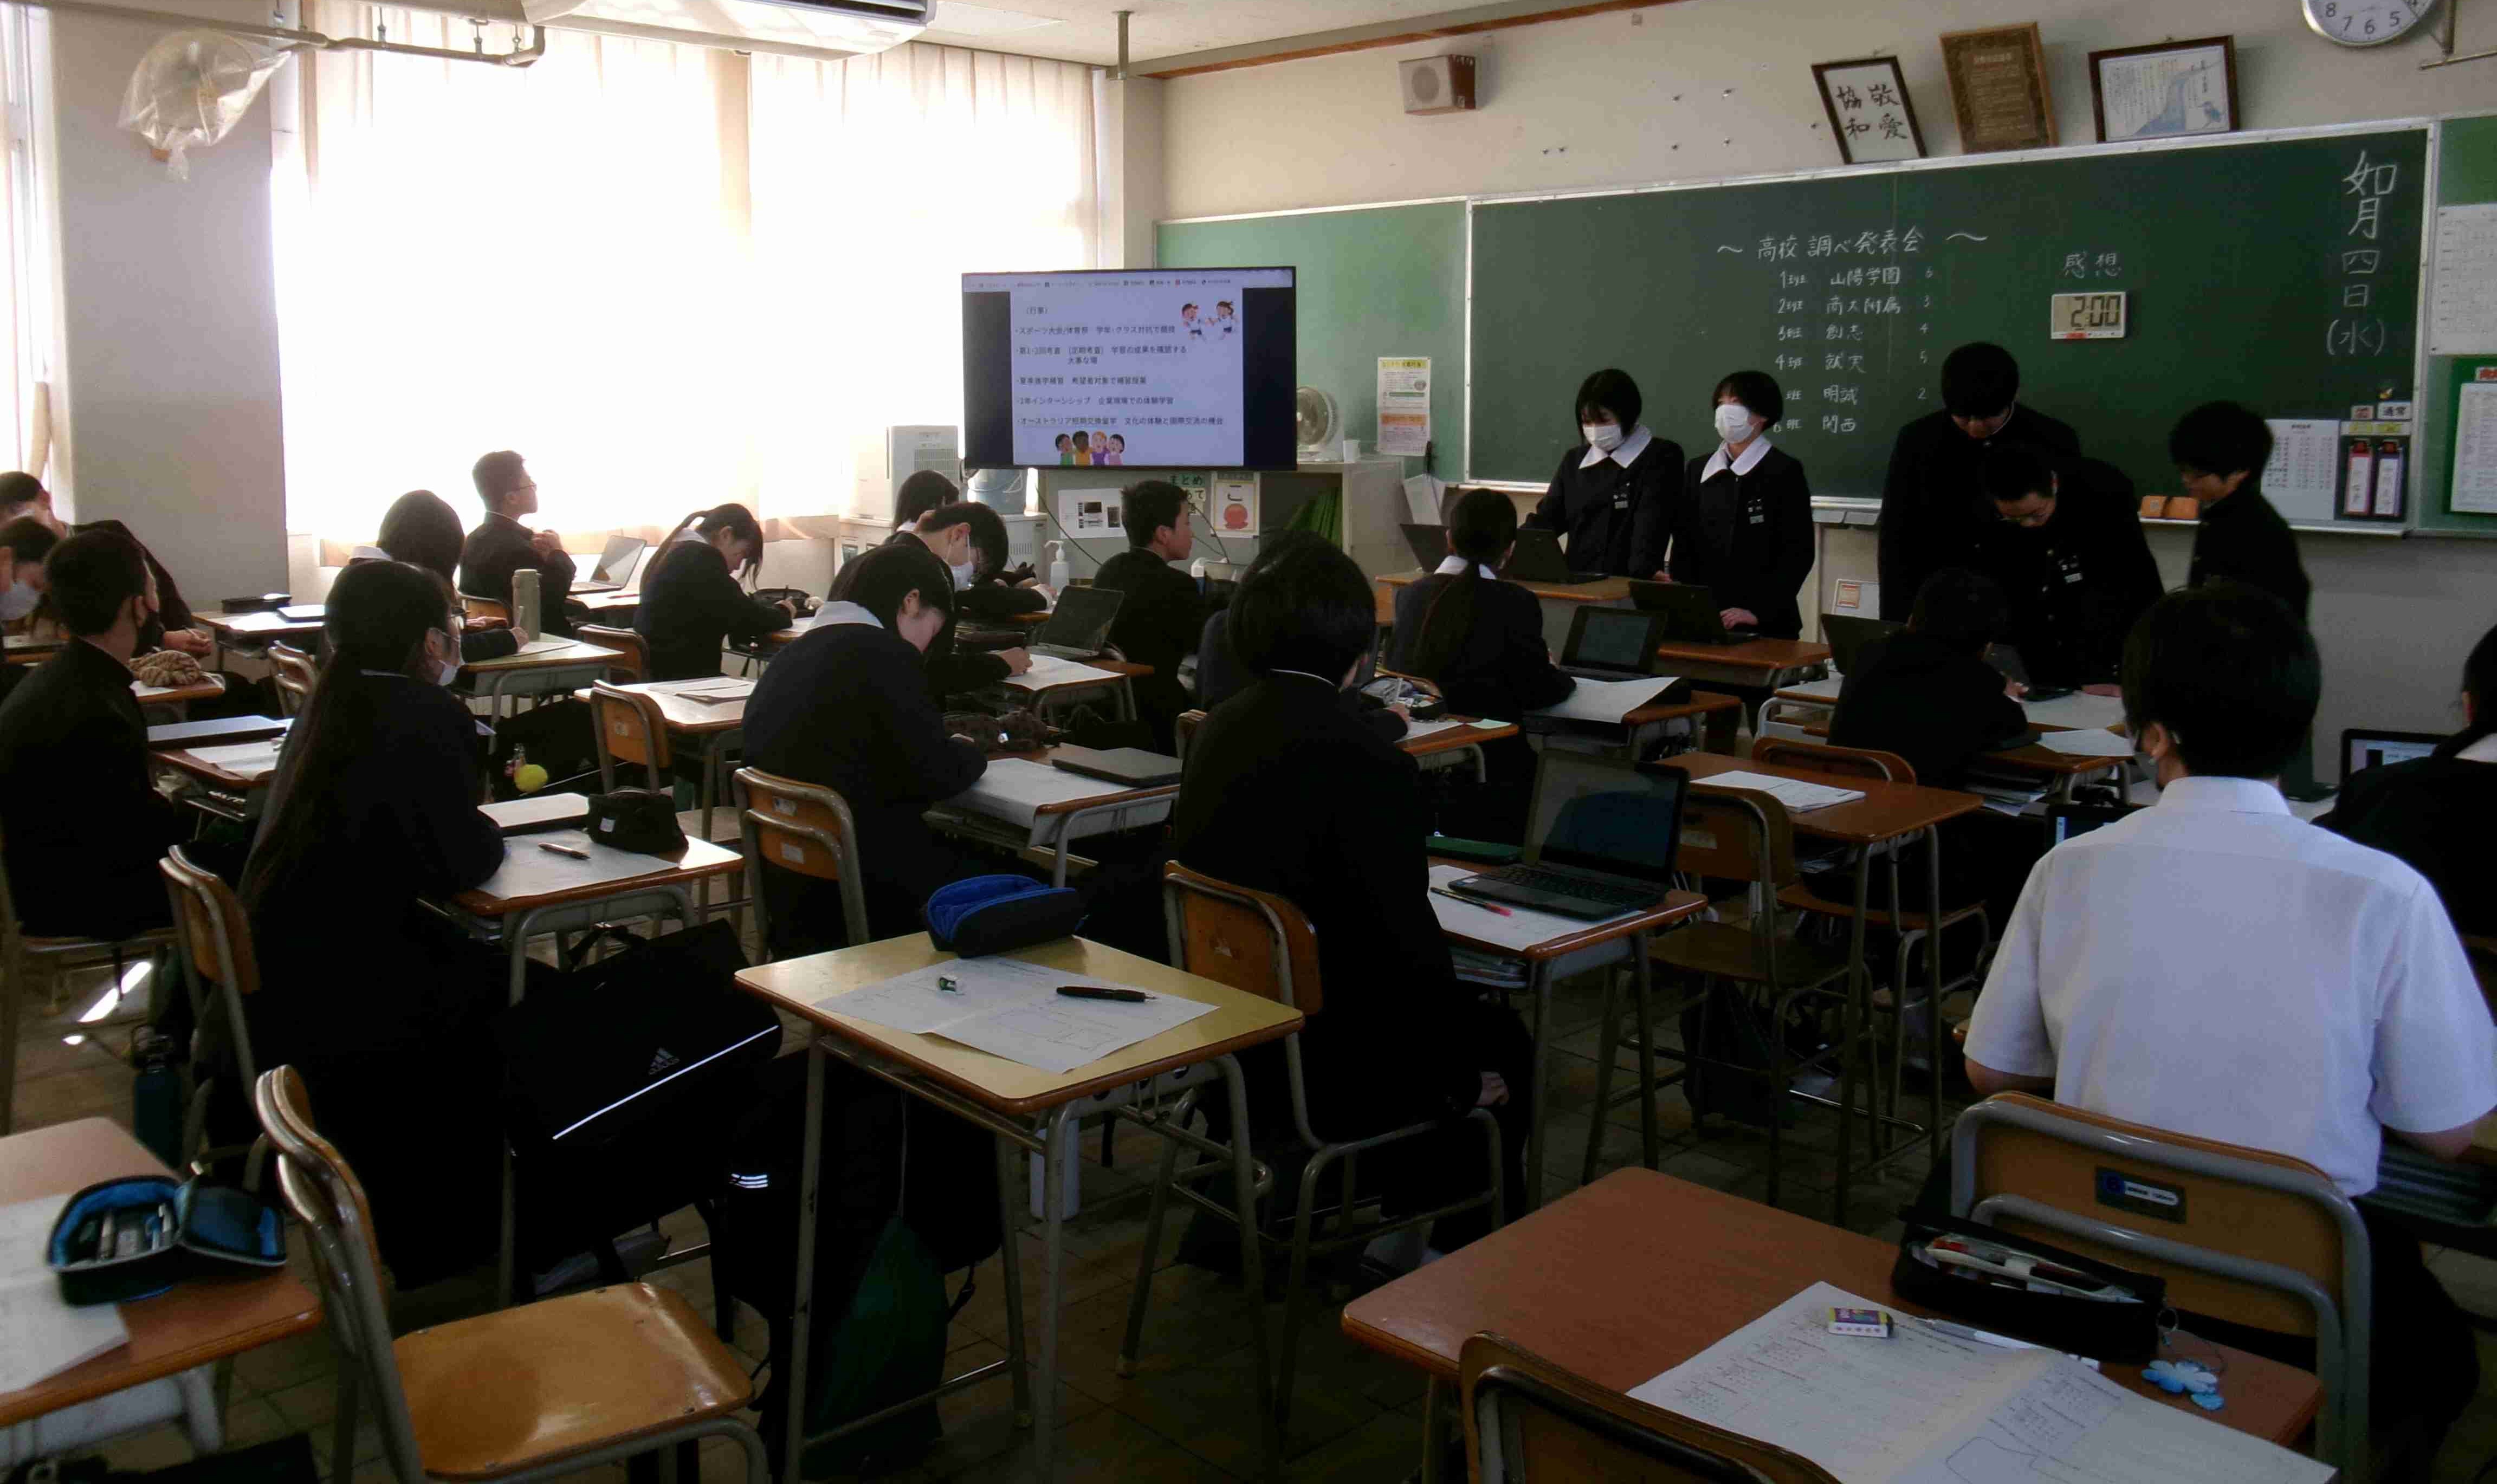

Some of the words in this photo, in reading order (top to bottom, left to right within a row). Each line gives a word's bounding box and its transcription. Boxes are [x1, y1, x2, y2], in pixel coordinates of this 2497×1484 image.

[2325, 2, 2336, 18] 8
[2389, 10, 2401, 27] 5
[2343, 15, 2352, 31] 7
[2364, 18, 2376, 35] 6
[2063, 249, 2123, 279] 感想
[1779, 270, 1808, 288] 1班
[1830, 266, 1901, 287] 山陽学園
[1777, 297, 1803, 314] 2班
[2070, 295, 2121, 327] 2:00
[1774, 353, 1804, 371] 4班
[1786, 388, 1802, 401] 班
